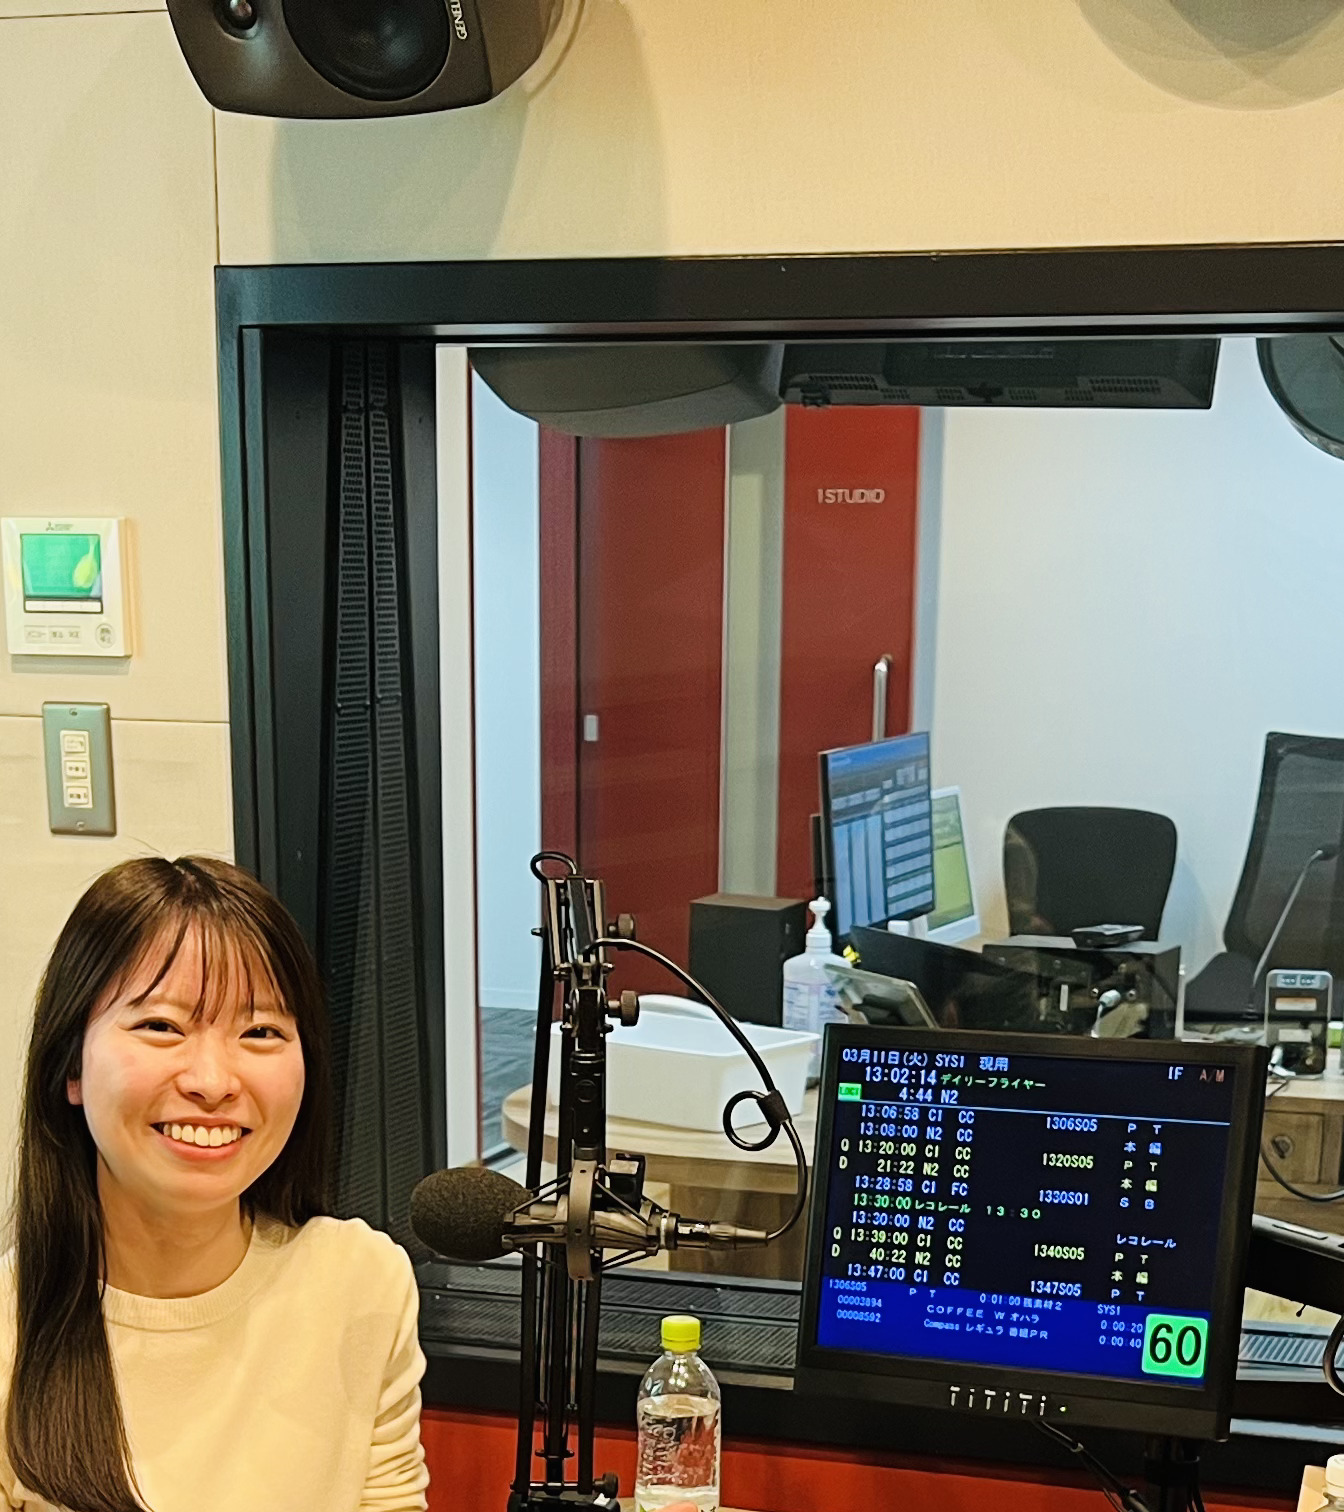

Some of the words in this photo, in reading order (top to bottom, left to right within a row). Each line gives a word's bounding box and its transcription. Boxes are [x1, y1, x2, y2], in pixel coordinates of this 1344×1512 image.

[451, 0, 467, 39] GENEL
[865, 1066, 937, 1085] 13:02:14
[899, 1087, 933, 1102] 4:44
[940, 1089, 959, 1104] N2
[861, 1104, 920, 1121] 13:06:58
[958, 1110, 975, 1124] CC
[1046, 1116, 1098, 1132] 1306S05
[860, 1121, 919, 1139] 13:08:00
[926, 1126, 943, 1140] N2
[956, 1128, 973, 1142] CC
[858, 1139, 917, 1156] 13:20:00
[955, 1146, 971, 1160] CC
[1042, 1153, 1094, 1169] 1320S05
[839, 1155, 848, 1169] D
[877, 1158, 915, 1175] 21:22
[923, 1162, 939, 1176] N2
[953, 1164, 970, 1178] CC
[853, 1193, 911, 1210] 13:30:00
[855, 1175, 913, 1192] 13:28:58
[951, 1182, 969, 1196] FC
[1039, 1189, 1089, 1205] 1330S01
[852, 1211, 910, 1228] 13:30:00
[918, 1216, 934, 1230] N2
[948, 1218, 965, 1232] CC
[831, 1244, 840, 1257] D
[869, 1247, 906, 1264] 40:22
[915, 1251, 931, 1266] N2
[945, 1254, 961, 1268] CC
[851, 1228, 908, 1245] 13:39:00
[947, 1236, 963, 1250] CC
[1034, 1244, 1085, 1260] 1340S05
[848, 1263, 905, 1280] 13:47:00
[943, 1272, 960, 1285] CC
[1030, 1280, 1082, 1297] 1347S05
[926, 1304, 984, 1318] COFFEE
[1149, 1323, 1202, 1367] 60
